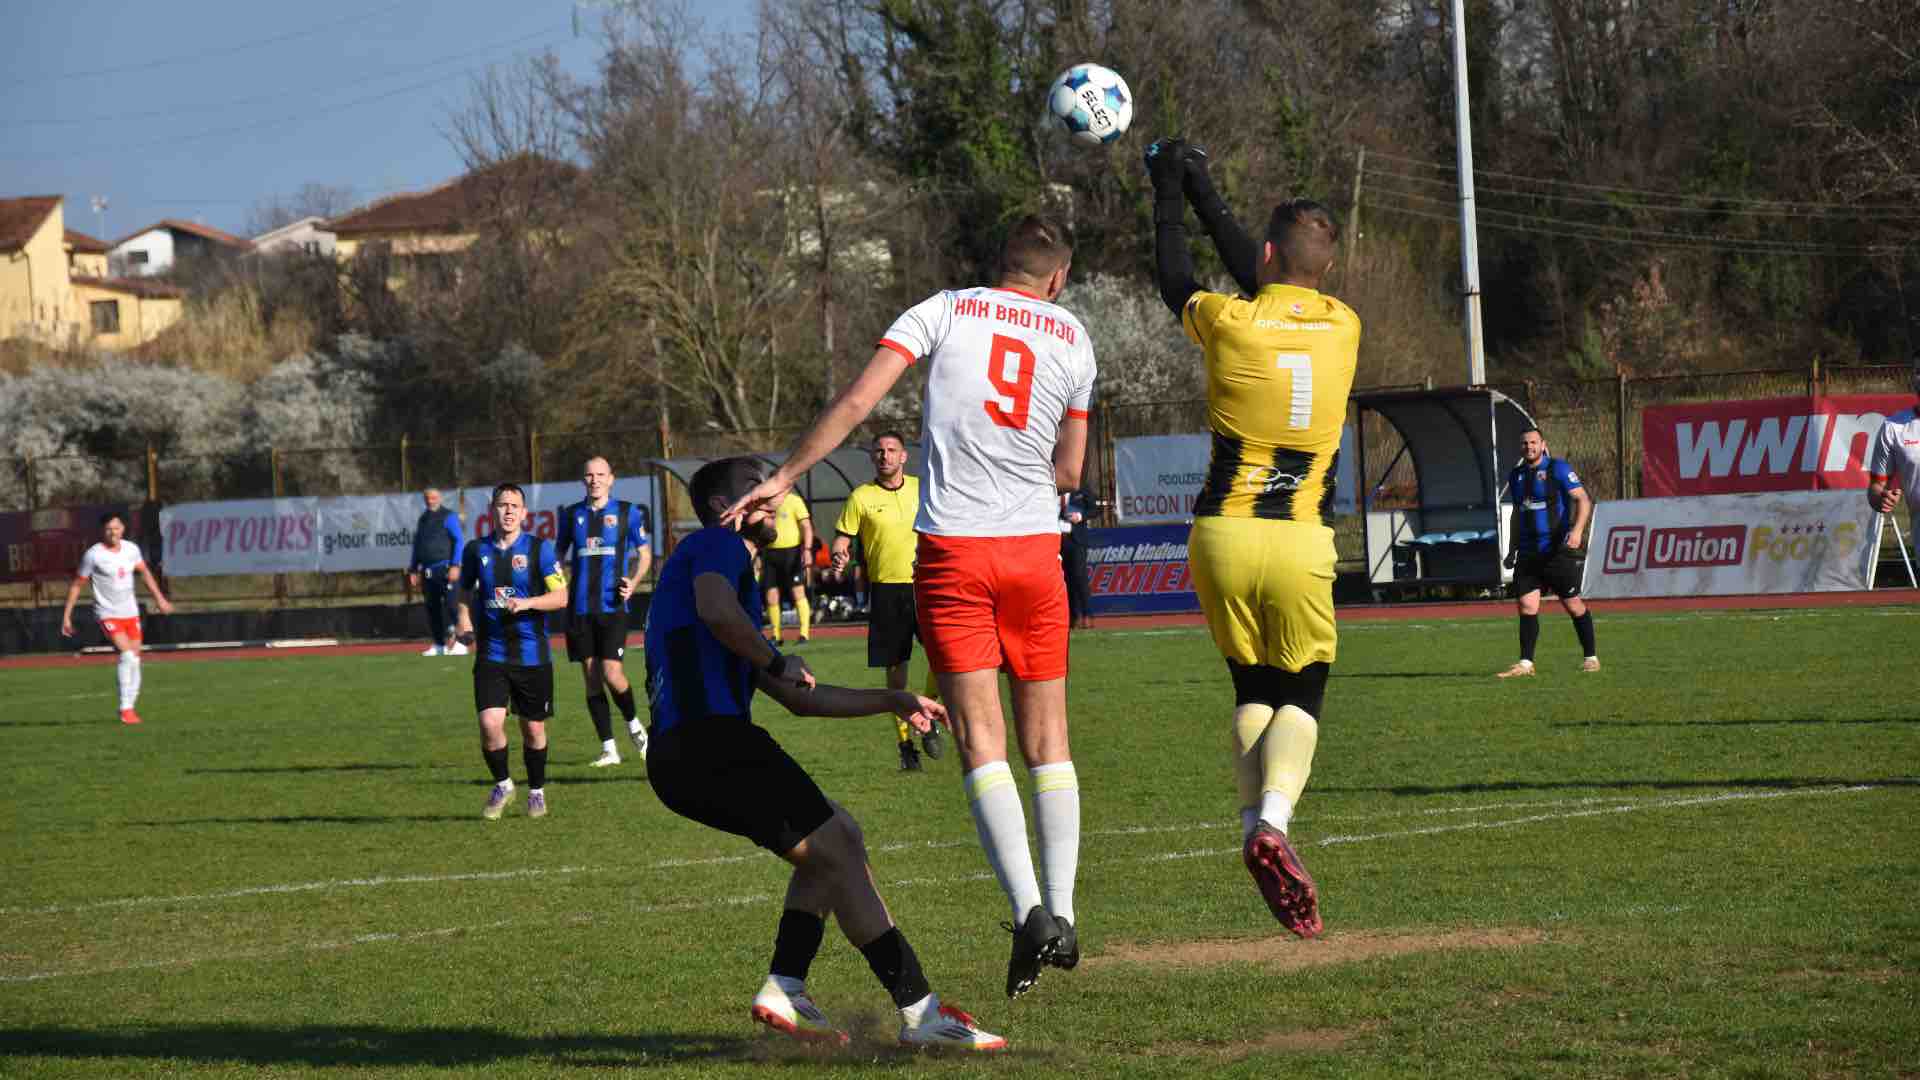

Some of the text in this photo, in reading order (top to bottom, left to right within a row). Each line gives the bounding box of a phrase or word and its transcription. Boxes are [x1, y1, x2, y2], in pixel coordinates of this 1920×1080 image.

[1081, 89, 1112, 127] SELECT
[954, 297, 1077, 345] HNK BROTNJO
[984, 333, 1036, 431] 9
[1276, 353, 1312, 431] 1
[1654, 530, 1737, 563] Union
